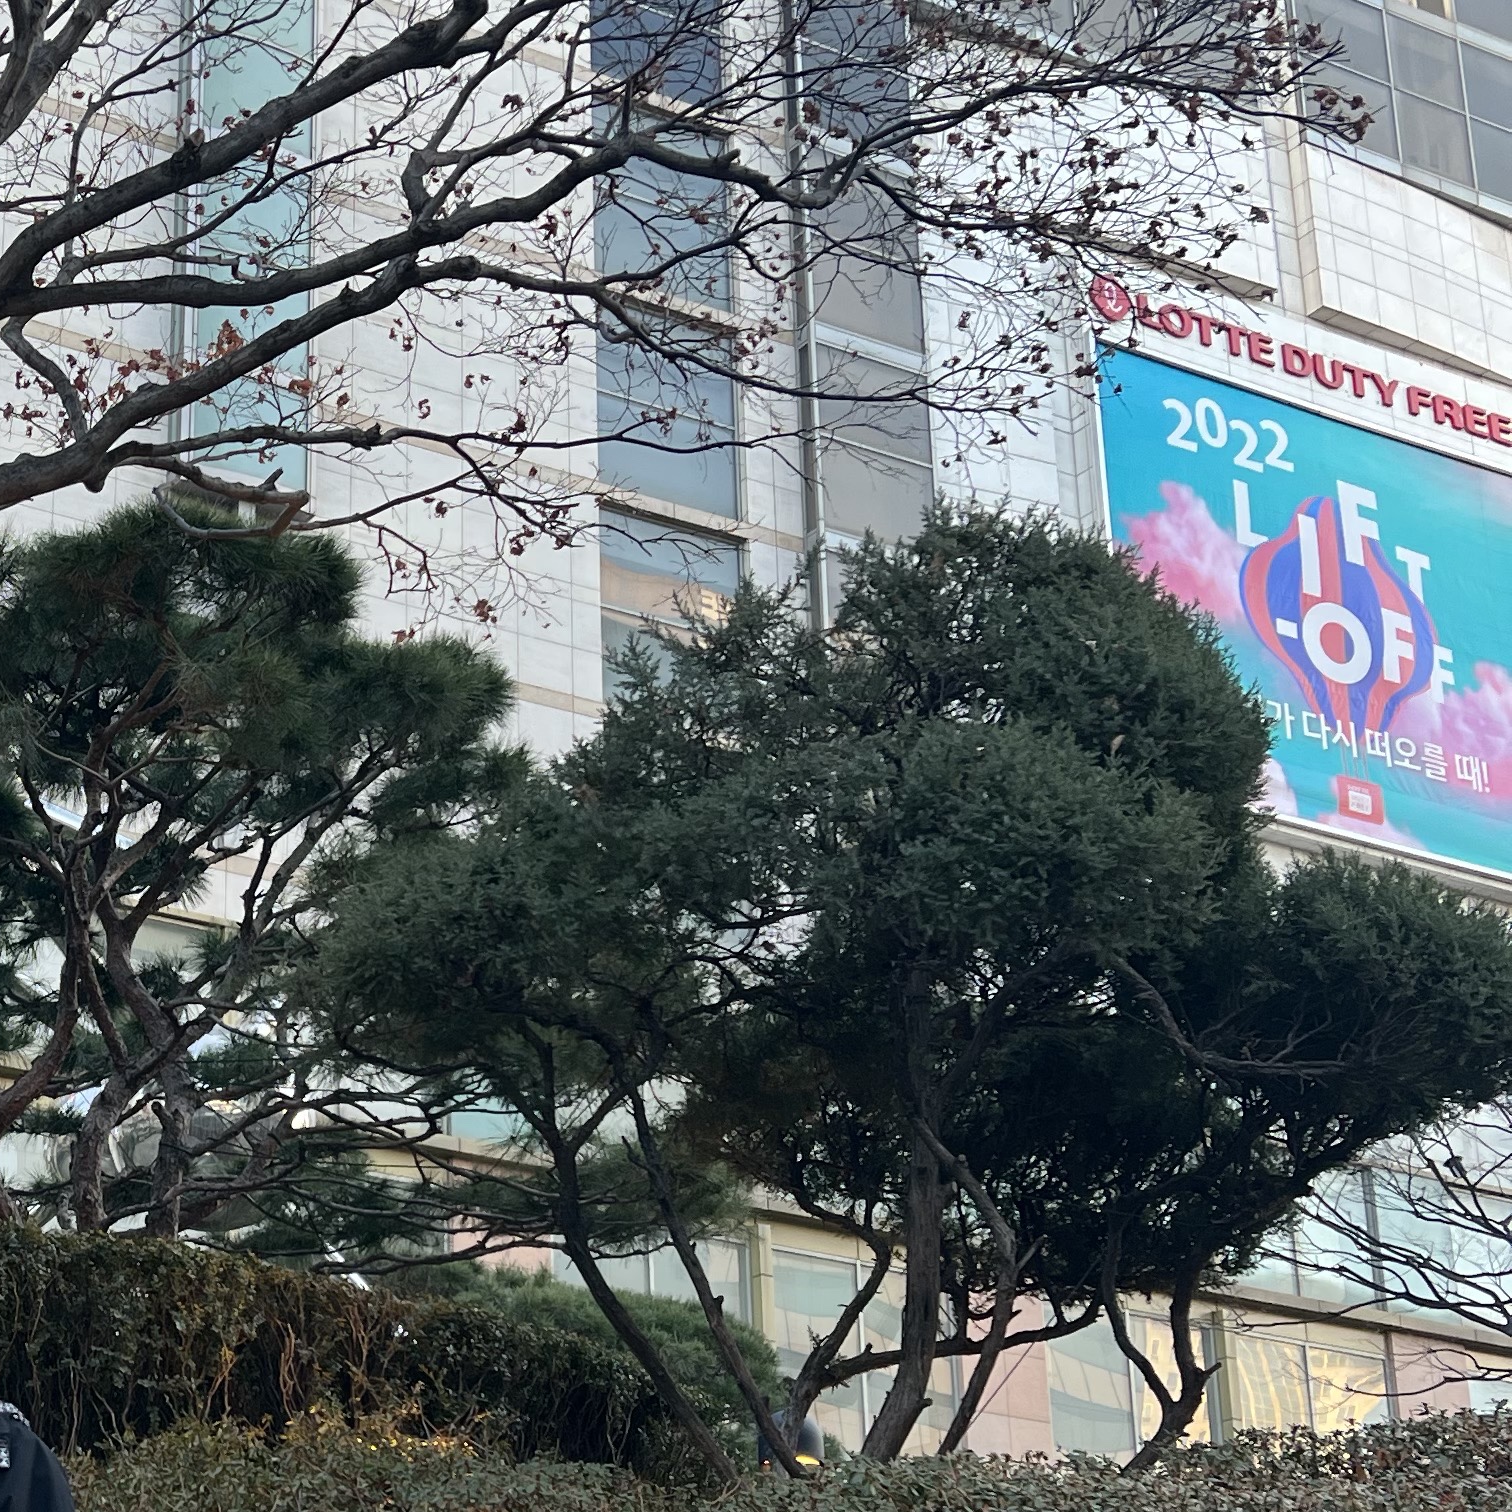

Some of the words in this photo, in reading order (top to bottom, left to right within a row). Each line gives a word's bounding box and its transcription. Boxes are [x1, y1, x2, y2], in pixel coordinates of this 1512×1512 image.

[1135, 293, 1275, 368] LOTTE
[1281, 343, 1399, 408] DUTY
[1405, 385, 1512, 448] FREE
[1162, 396, 1296, 473] 2022
[1301, 710, 1358, 758] 다시
[1364, 727, 1449, 783] 떠오를
[1454, 753, 1491, 794] 때!
